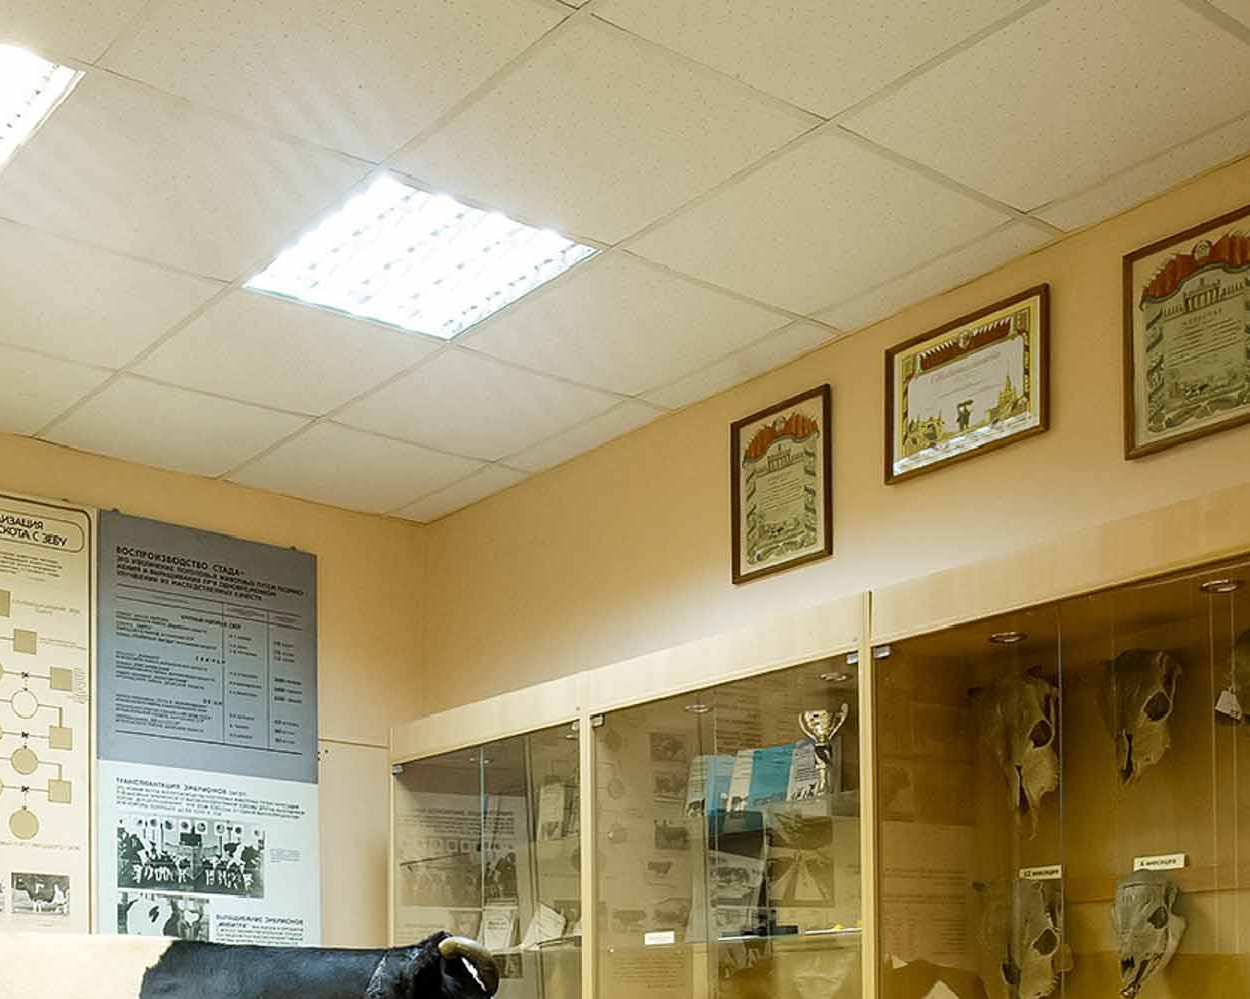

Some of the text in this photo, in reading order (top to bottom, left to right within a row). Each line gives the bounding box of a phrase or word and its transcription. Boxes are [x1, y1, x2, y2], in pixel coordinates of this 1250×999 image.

[32, 531, 40, 542] С
[41, 533, 68, 547] ЗЕБУ
[116, 546, 208, 570] ВОСПРОИЗВОДСТВО
